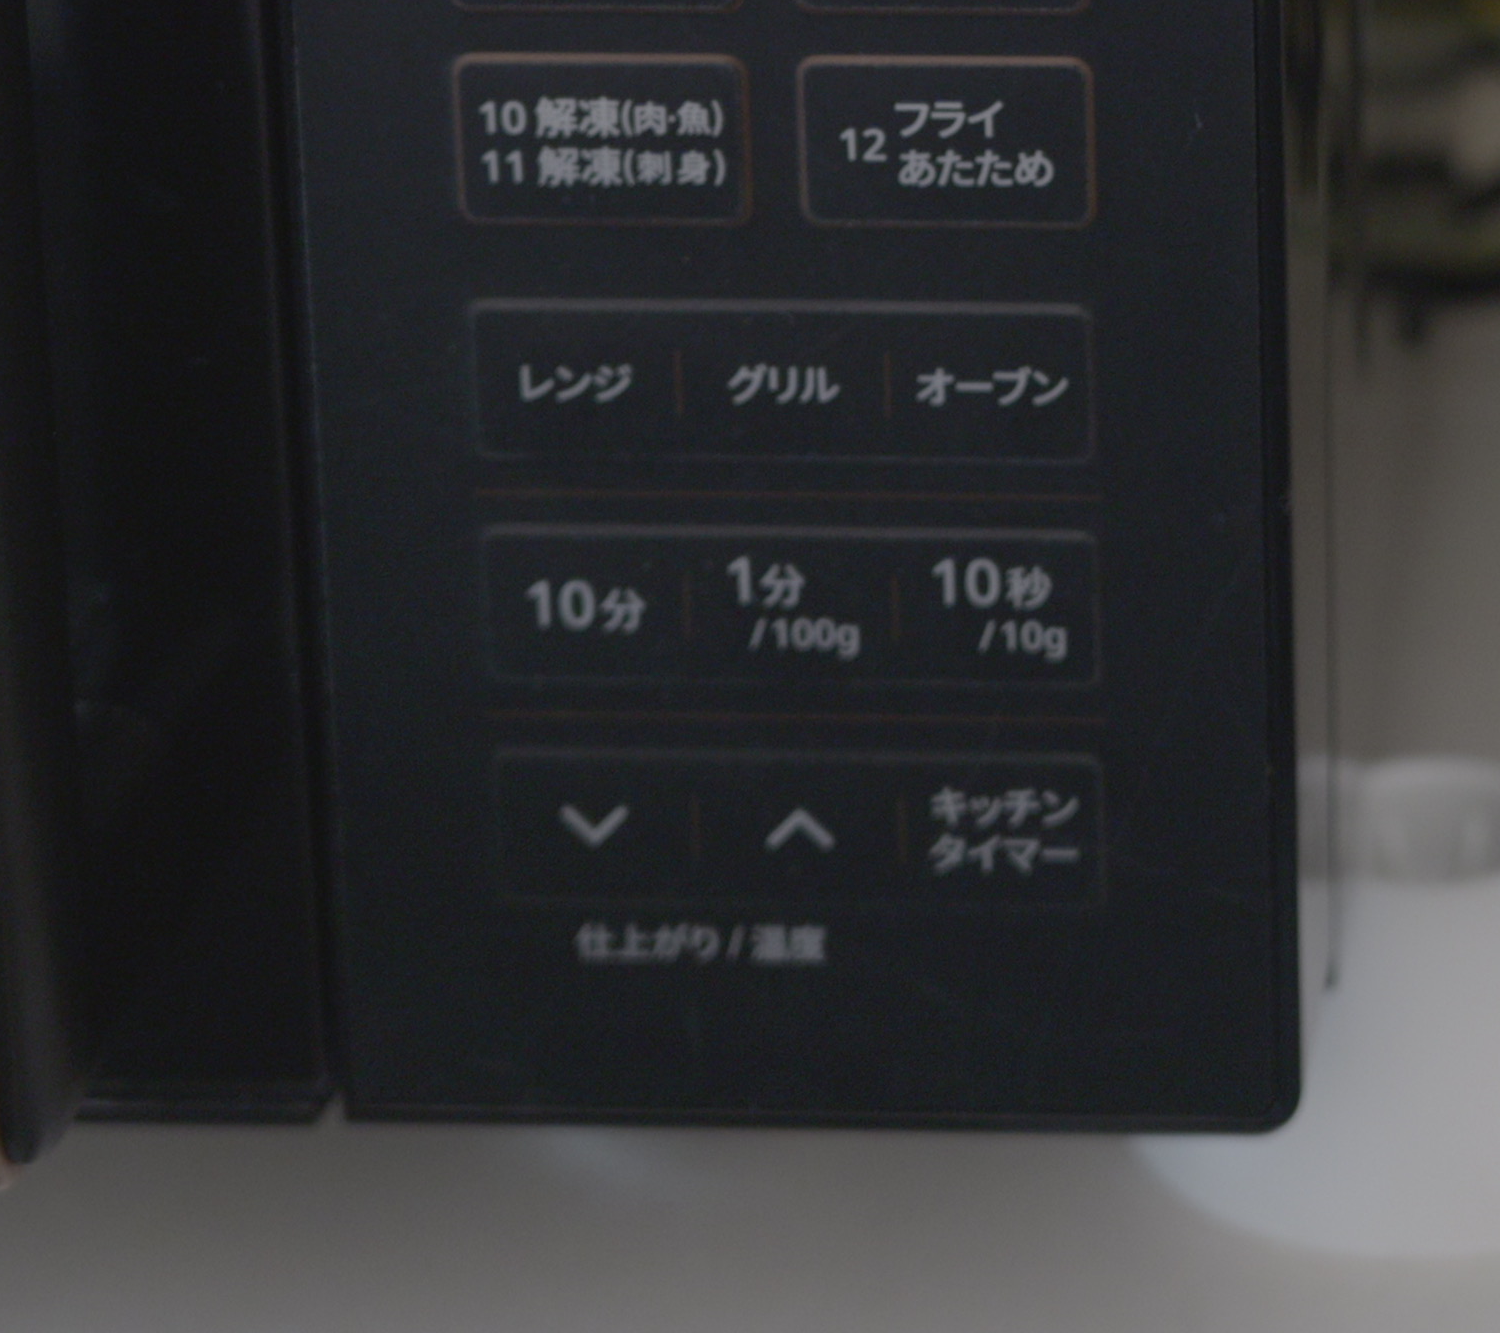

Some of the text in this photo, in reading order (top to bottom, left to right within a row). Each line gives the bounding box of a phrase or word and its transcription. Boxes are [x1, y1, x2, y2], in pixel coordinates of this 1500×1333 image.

[478, 99, 529, 137] 10
[893, 99, 1005, 140] フライ
[839, 126, 888, 163] 12
[481, 148, 525, 184] 11
[897, 148, 1056, 188] あたため
[518, 362, 633, 404] レンジ
[727, 362, 841, 406] グリル
[915, 365, 1070, 407] オーブン
[726, 554, 806, 609] 1分
[931, 556, 1053, 610] 10秒
[526, 578, 647, 633] 10分
[931, 786, 1079, 827] キッチン
[928, 832, 1080, 873] タイマー
